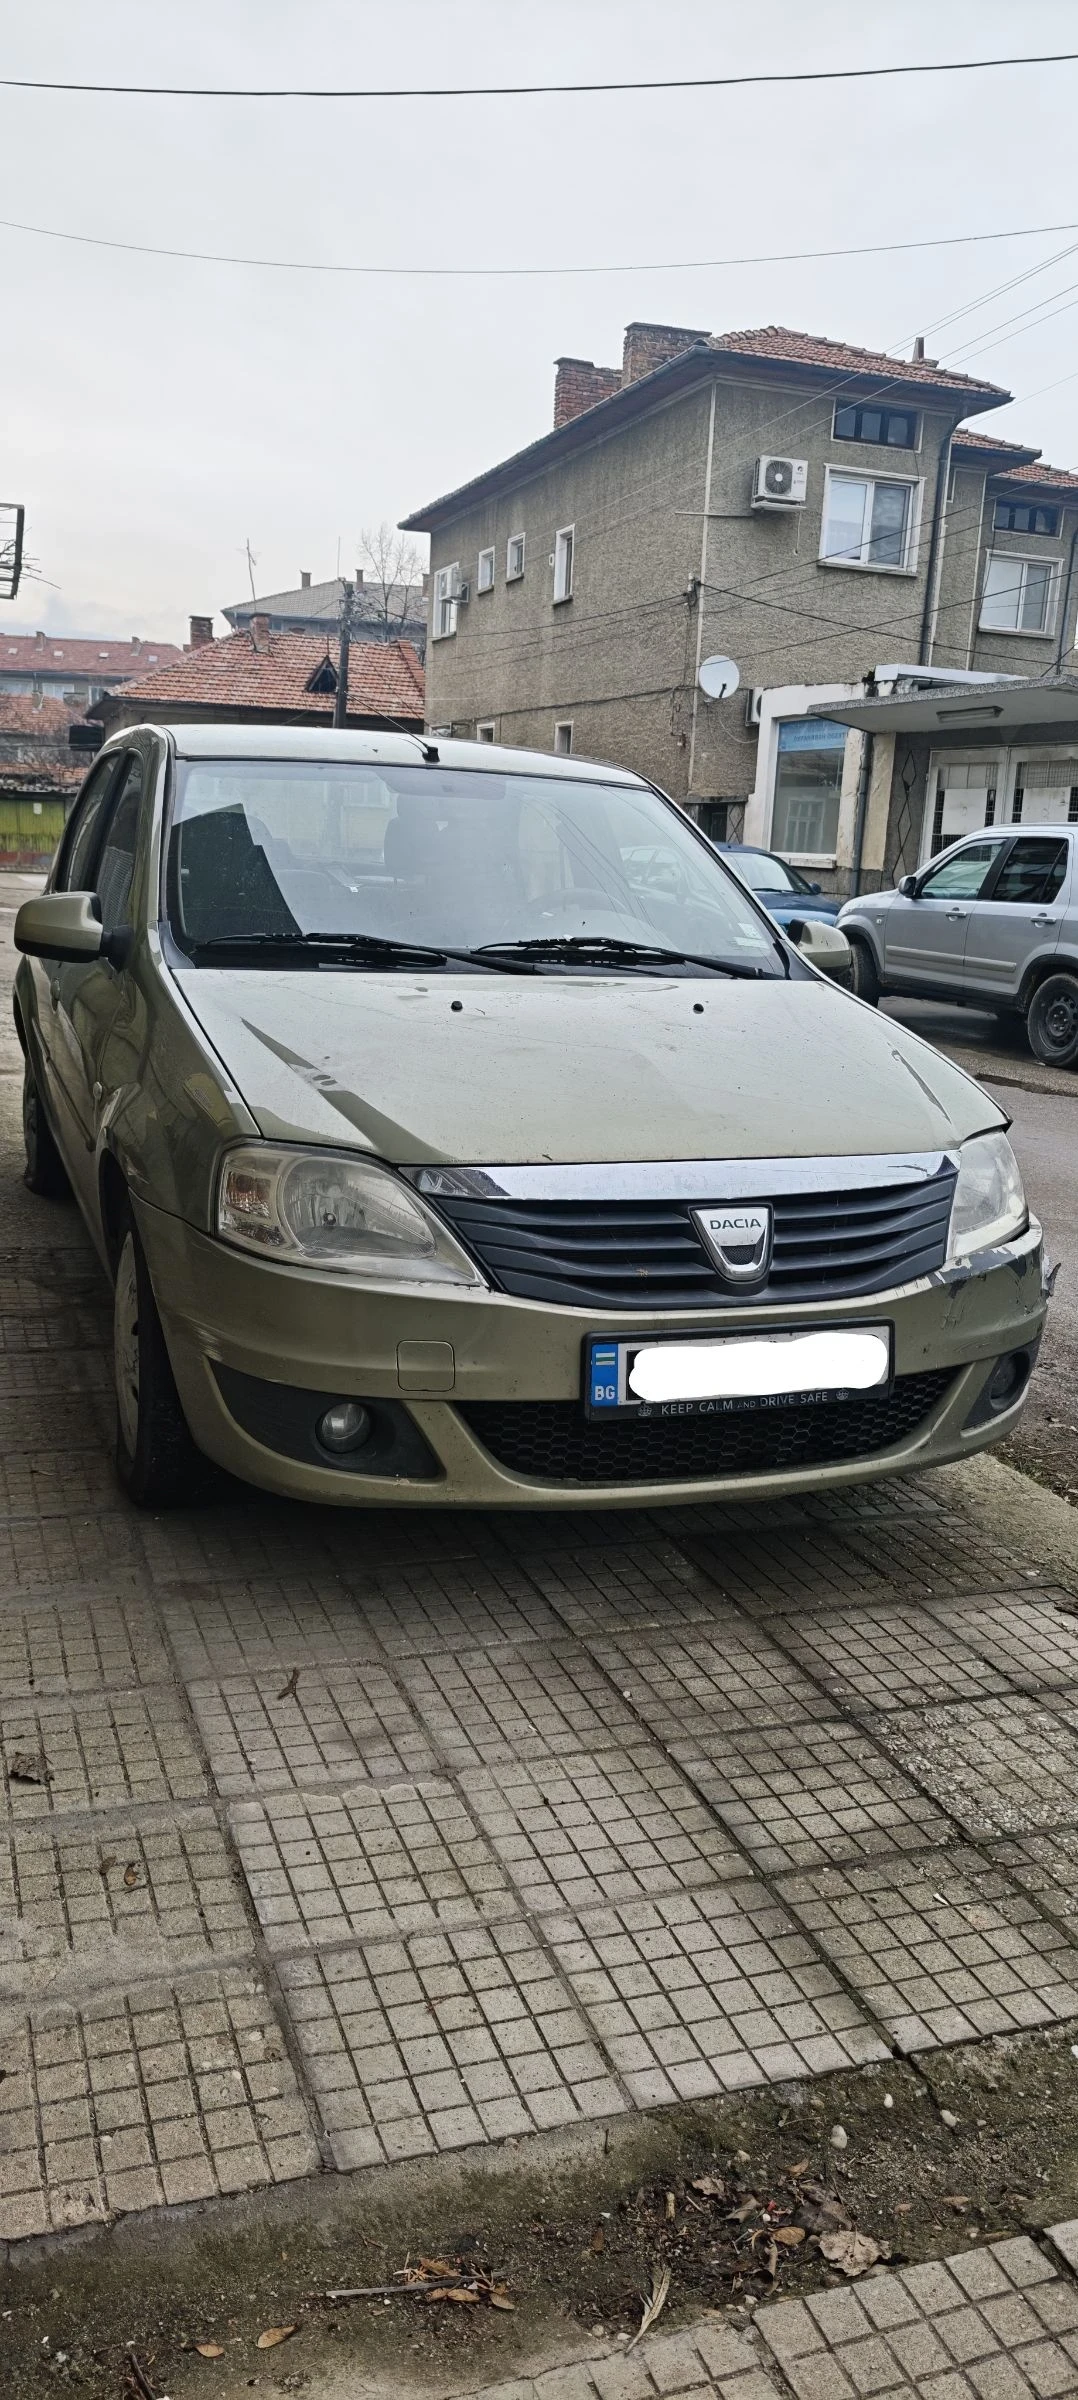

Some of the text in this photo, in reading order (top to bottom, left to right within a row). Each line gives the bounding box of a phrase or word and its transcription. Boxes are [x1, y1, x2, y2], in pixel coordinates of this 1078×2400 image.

[710, 1218, 761, 1230] DACIA
[594, 1385, 616, 1401] BG
[661, 1403, 693, 1415] KEEP
[699, 1400, 733, 1412] CALM
[760, 1394, 795, 1407] DRIVE
[800, 1391, 828, 1404] SAFE
